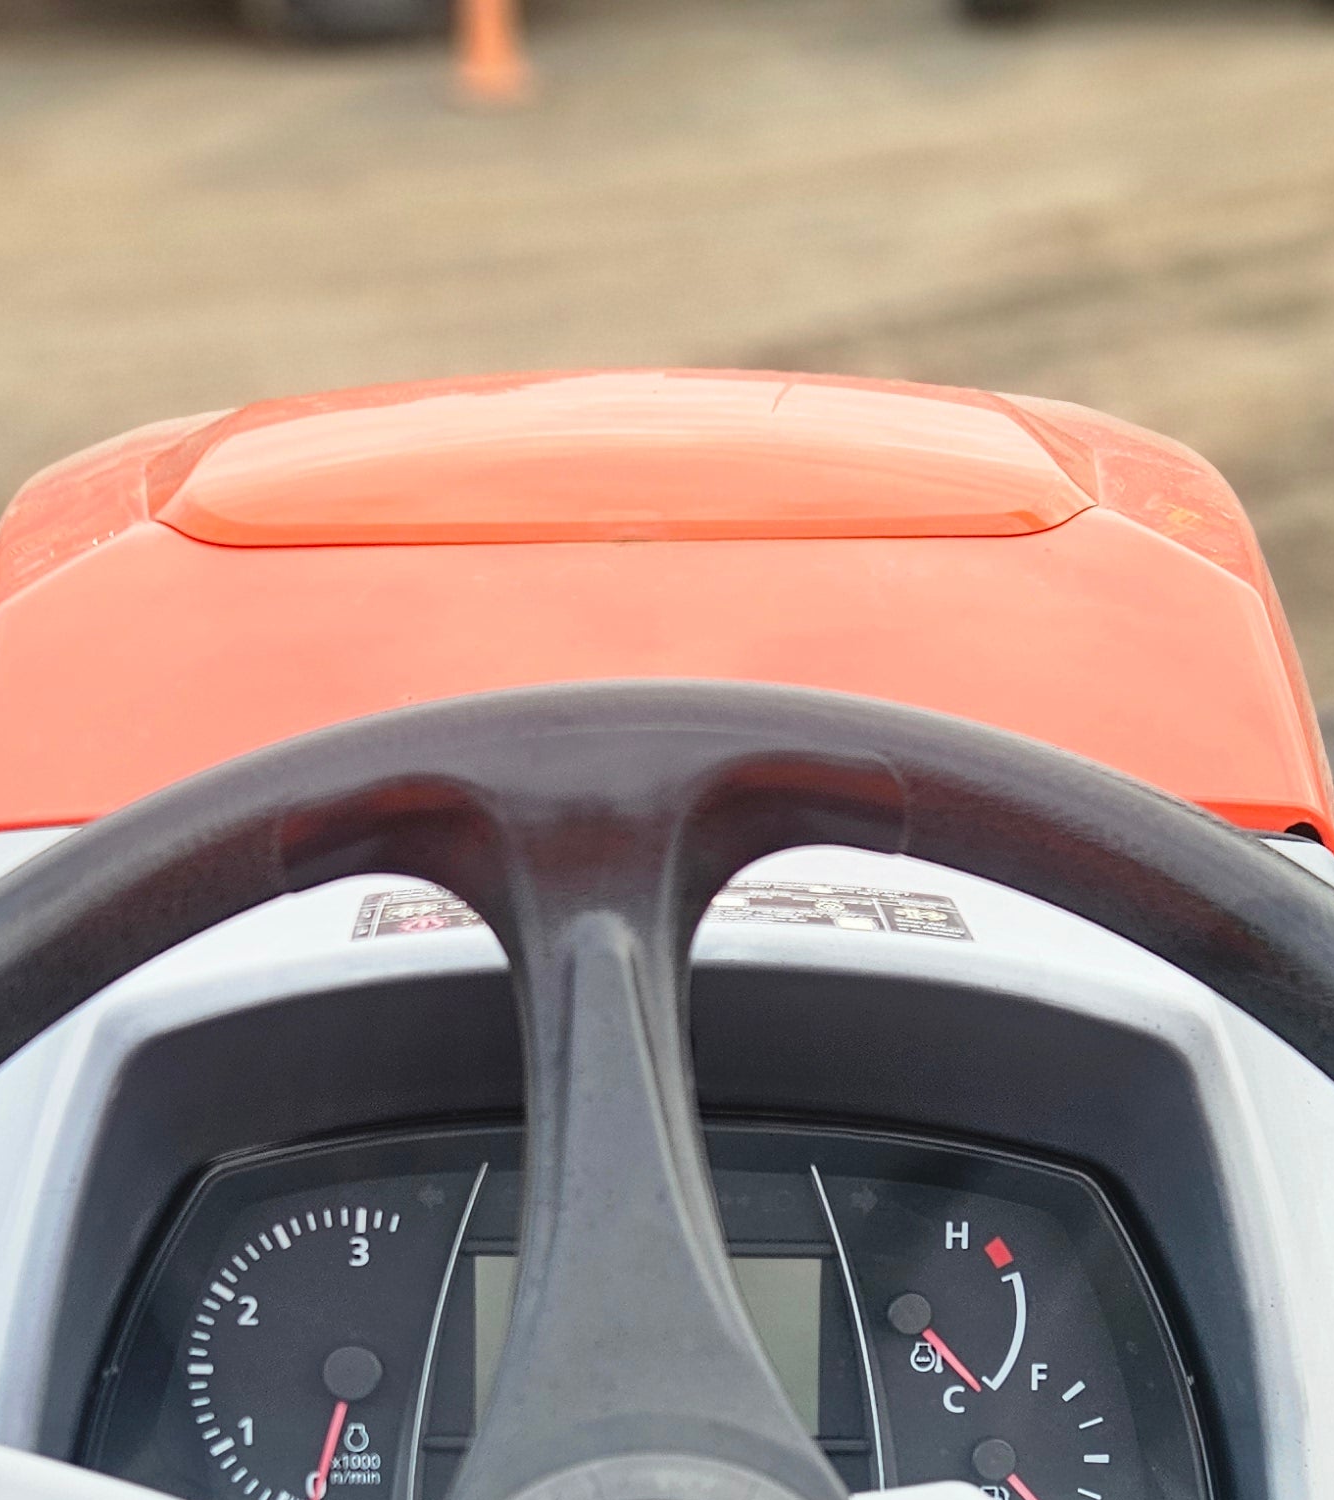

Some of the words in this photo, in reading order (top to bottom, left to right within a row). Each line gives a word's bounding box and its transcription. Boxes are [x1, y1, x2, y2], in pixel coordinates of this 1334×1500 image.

[945, 1222, 969, 1249] H
[349, 1237, 369, 1267] 3
[237, 1297, 259, 1326] 2
[1031, 1363, 1048, 1391] F
[943, 1386, 965, 1413] C
[237, 1416, 254, 1446] 1
